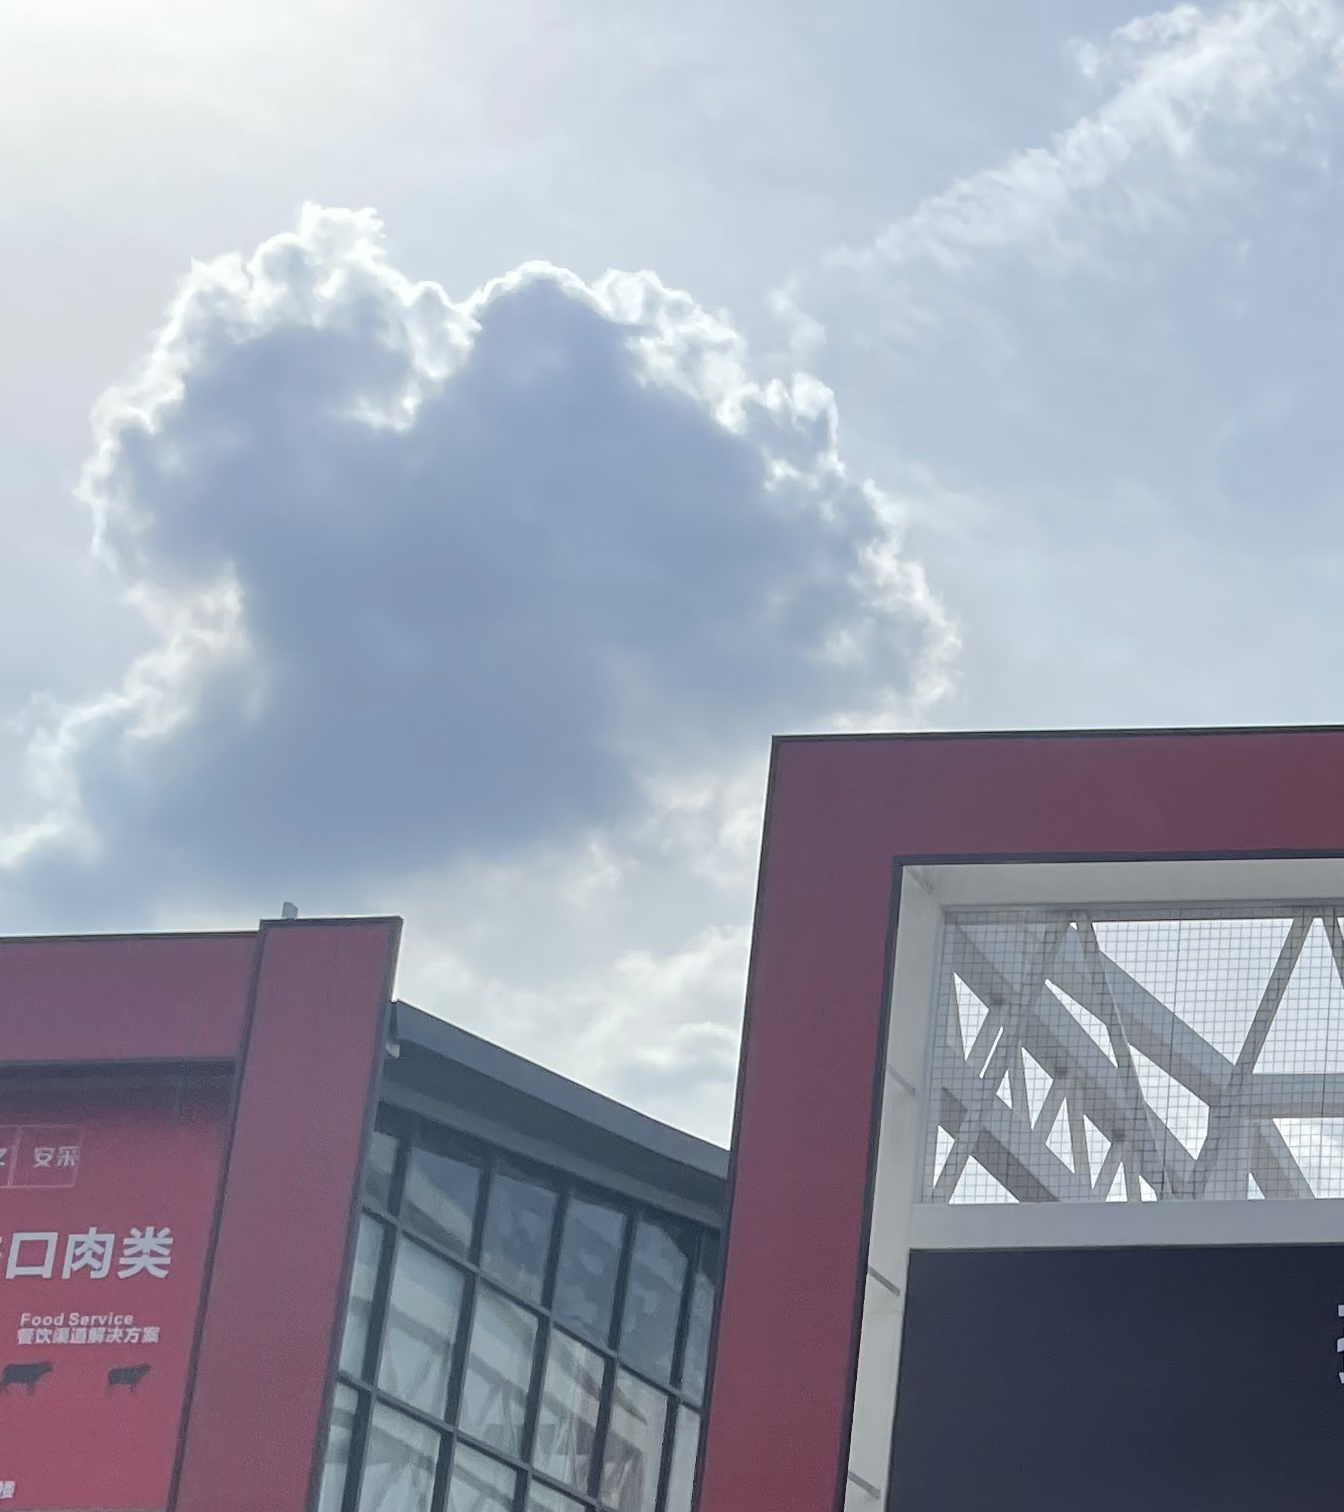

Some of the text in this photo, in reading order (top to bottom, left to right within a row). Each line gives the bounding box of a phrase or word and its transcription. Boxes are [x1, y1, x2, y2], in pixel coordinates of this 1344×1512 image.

[0, 1226, 174, 1280] 口肉类
[20, 1312, 134, 1326] Food Service
